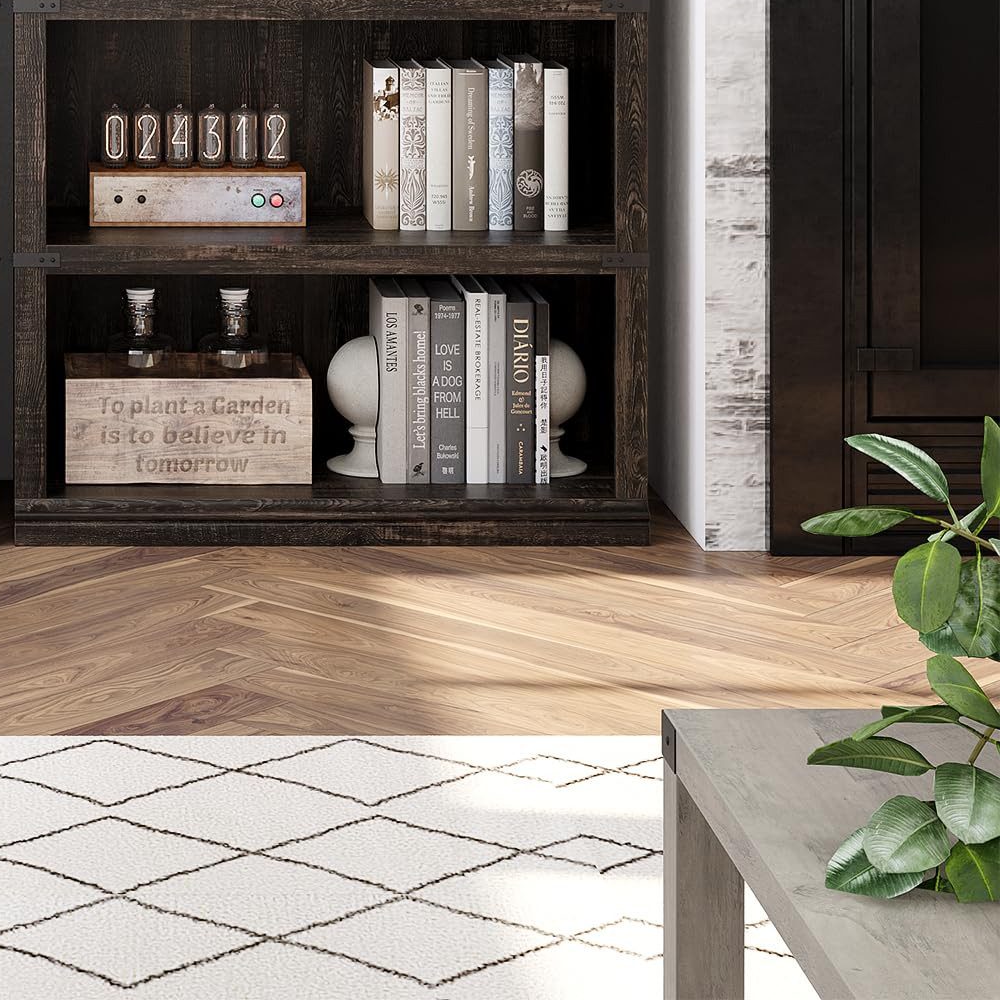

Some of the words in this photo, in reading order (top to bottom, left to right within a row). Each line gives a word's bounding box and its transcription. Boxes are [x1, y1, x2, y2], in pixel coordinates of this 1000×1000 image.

[466, 87, 475, 117] Dreaming
[467, 126, 475, 150] Sweden
[386, 312, 398, 328] LOS
[386, 330, 398, 373] AMANTES
[413, 331, 426, 362] home!
[435, 344, 460, 355] LOVE
[513, 319, 533, 384] DIÁRIO
[443, 360, 453, 371] IS
[413, 363, 426, 396] blacks
[432, 376, 441, 386] A
[441, 376, 463, 386] DOG
[99, 397, 125, 414] To
[129, 396, 187, 419] plant
[192, 401, 206, 415] a
[211, 395, 291, 415] Garden
[434, 391, 462, 402] FROM
[413, 396, 429, 424] bring
[436, 408, 460, 419] HELL
[101, 426, 120, 444] is
[128, 428, 154, 445] to
[162, 425, 256, 445] believe
[263, 426, 287, 444] in
[413, 426, 426, 449] Let's
[135, 455, 249, 473] tomorrow
